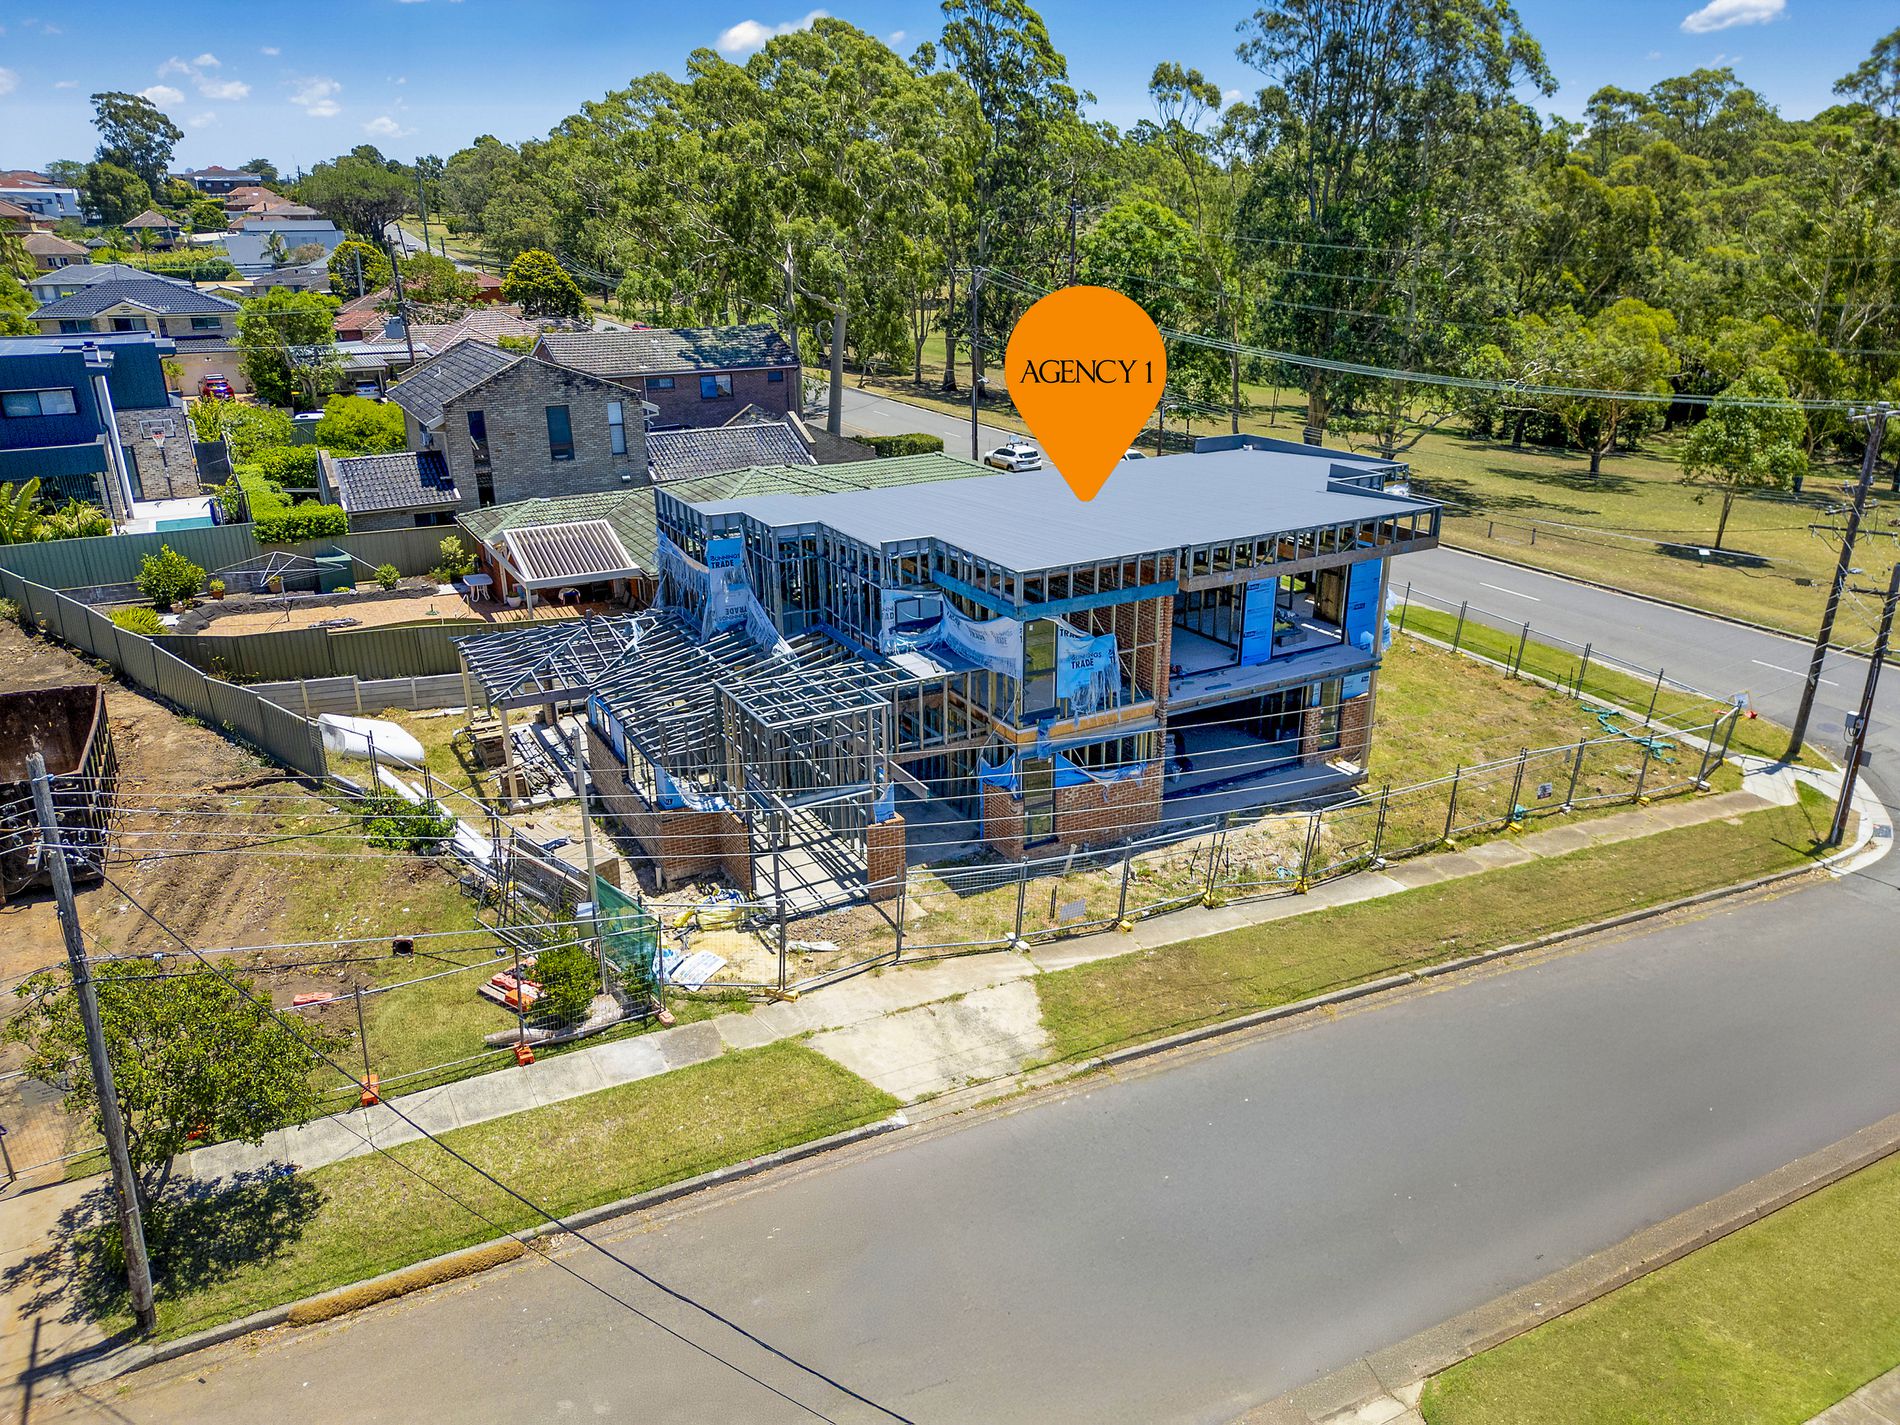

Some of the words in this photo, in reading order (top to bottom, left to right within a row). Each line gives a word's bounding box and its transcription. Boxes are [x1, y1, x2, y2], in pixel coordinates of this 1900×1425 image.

[711, 560, 734, 568] TRADE
[725, 606, 748, 615] TRADE
[1070, 658, 1094, 670] TRADE
